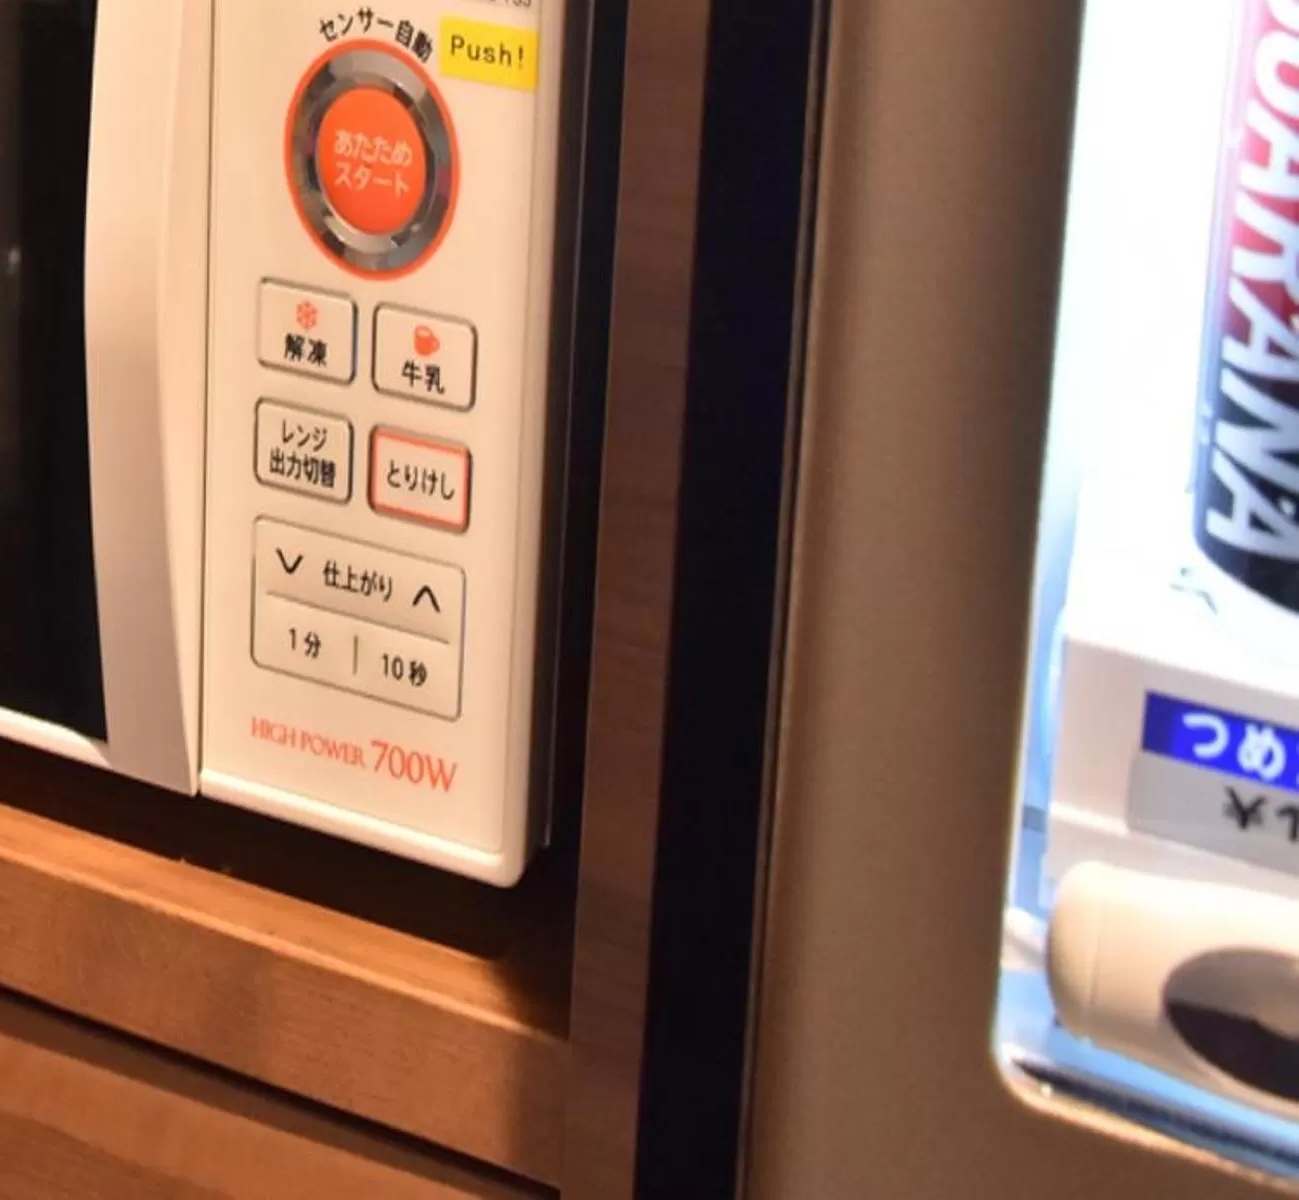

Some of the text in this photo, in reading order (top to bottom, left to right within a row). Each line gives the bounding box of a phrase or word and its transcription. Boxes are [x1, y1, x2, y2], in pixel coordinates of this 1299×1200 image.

[318, 6, 433, 64] センサー自動
[450, 34, 525, 70] Push!
[334, 129, 413, 168] あたため
[334, 161, 410, 198] スタート
[283, 332, 328, 367] 解凍
[401, 358, 445, 395] 牛乳
[281, 418, 328, 452] レンジ
[269, 448, 336, 489] 出力切替
[386, 459, 455, 501] とりけし
[323, 559, 393, 602] 仕上がり
[251, 716, 459, 793] HIGH POWER 700W
[1181, 711, 1299, 786] つめ
